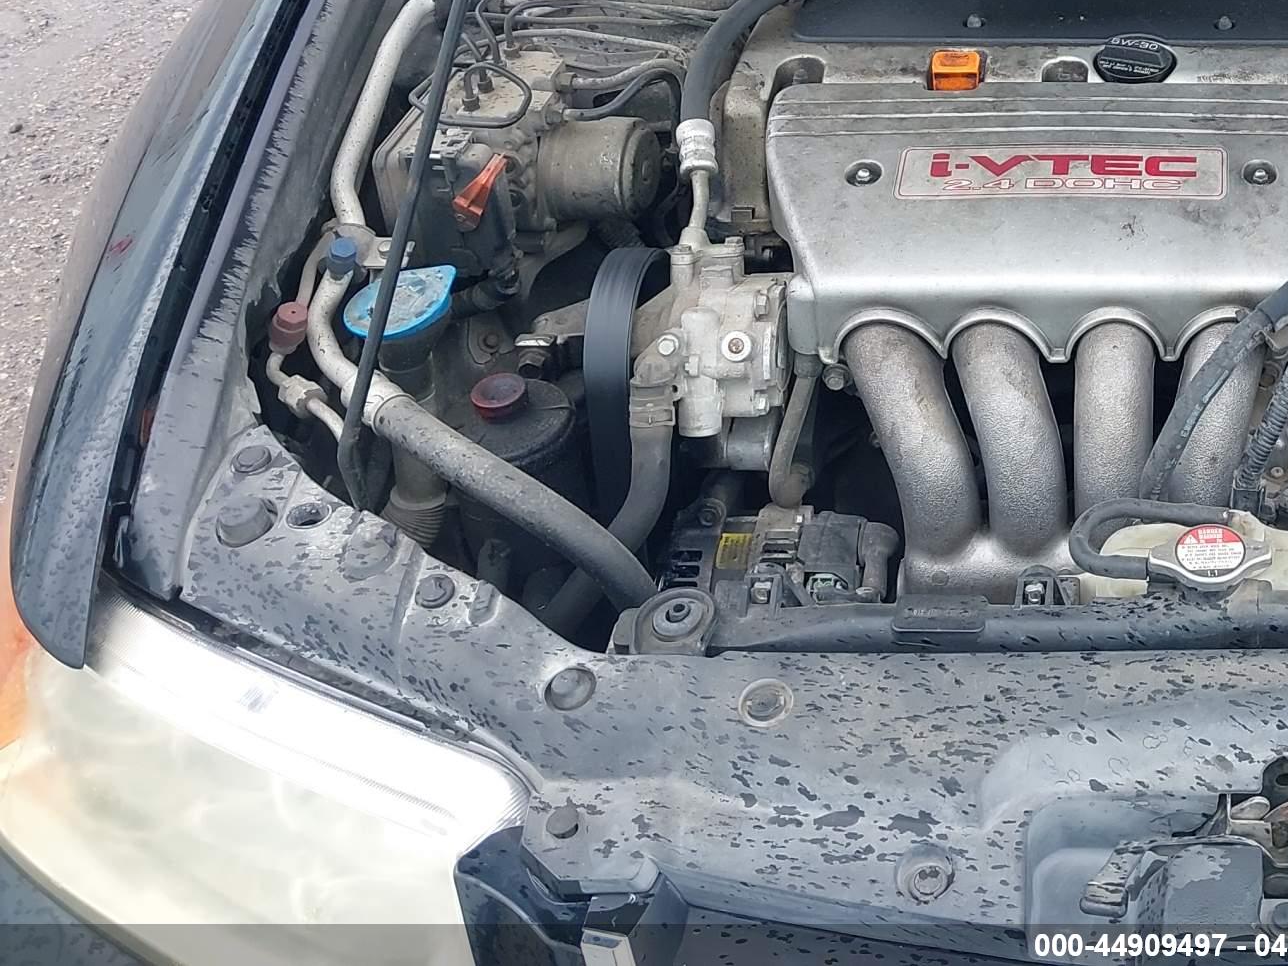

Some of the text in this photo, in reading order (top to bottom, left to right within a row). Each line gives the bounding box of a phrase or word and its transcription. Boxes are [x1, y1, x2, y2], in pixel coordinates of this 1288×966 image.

[1110, 37, 1159, 51] 5W-30
[929, 152, 1197, 178] i-VTEC
[943, 177, 1182, 191] 2.4 DOHC
